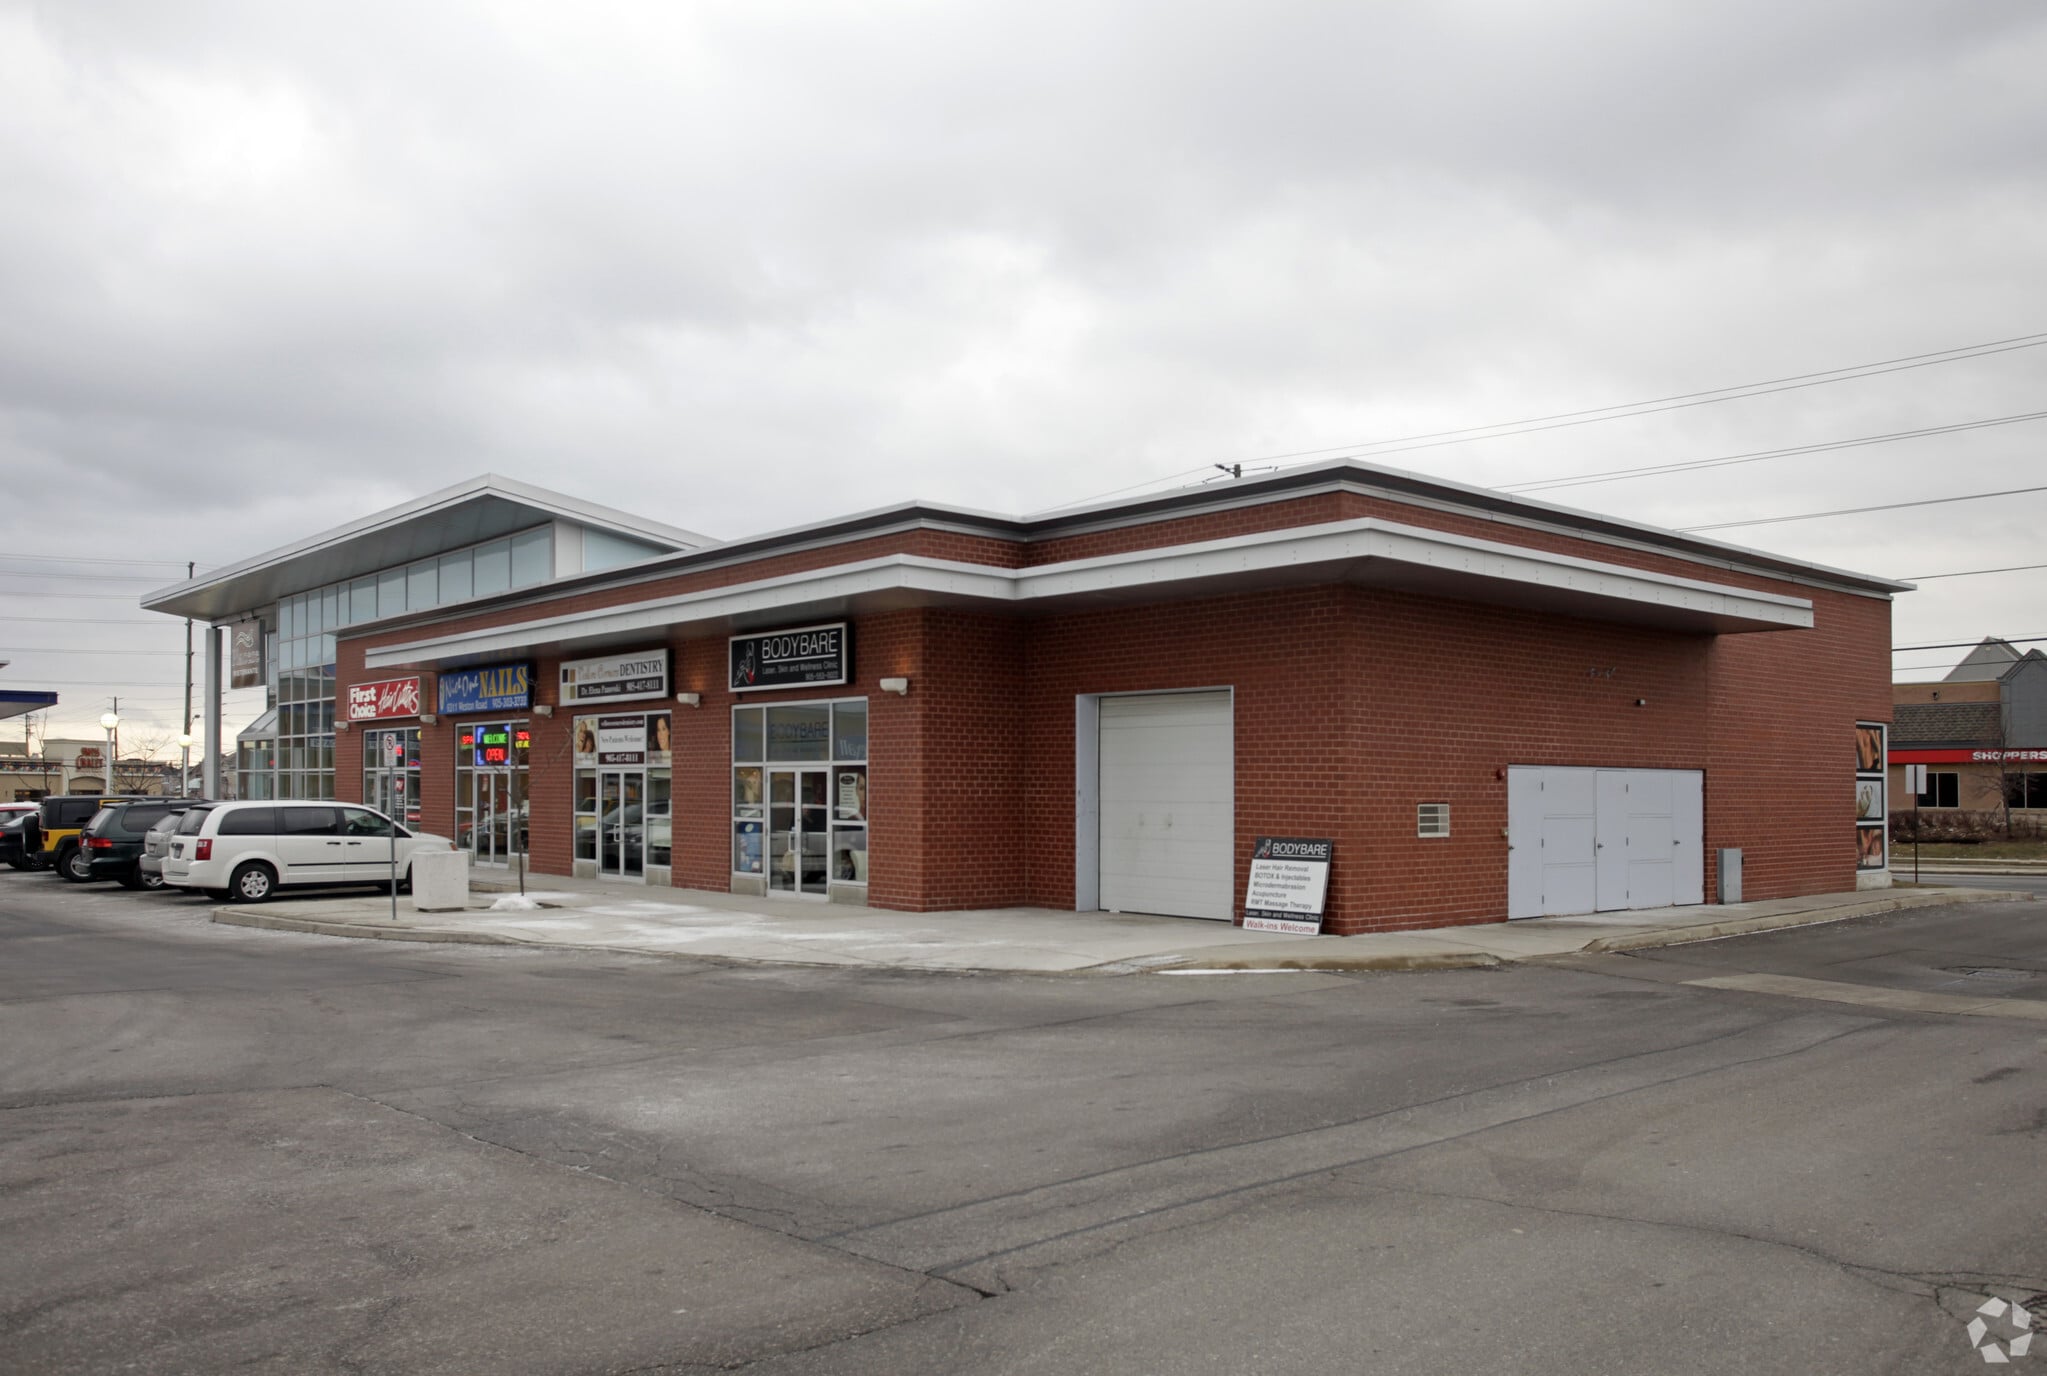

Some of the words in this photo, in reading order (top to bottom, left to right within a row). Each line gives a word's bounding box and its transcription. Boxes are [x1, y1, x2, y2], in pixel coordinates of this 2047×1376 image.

[762, 631, 838, 659] BODYBARE
[620, 659, 663, 677] DENTISTRY
[479, 665, 528, 699] NAILS
[350, 686, 377, 703] First
[350, 703, 377, 719] Choice
[483, 732, 507, 745] WELCOME
[486, 747, 504, 762] OPEN
[1972, 750, 2047, 761] SHOPPERS
[1272, 842, 1328, 856] BODYBARE
[1272, 863, 1283, 871] Hair
[1284, 864, 1309, 872] Removal
[1255, 872, 1274, 880] BOTOX
[1252, 889, 1287, 899] Acupuncture
[1264, 898, 1288, 909] Massage
[1289, 900, 1312, 911] Therapy
[1305, 913, 1319, 921] Clinic
[1246, 919, 1278, 931] Walk-ins
[1280, 922, 1316, 934] Welcome
